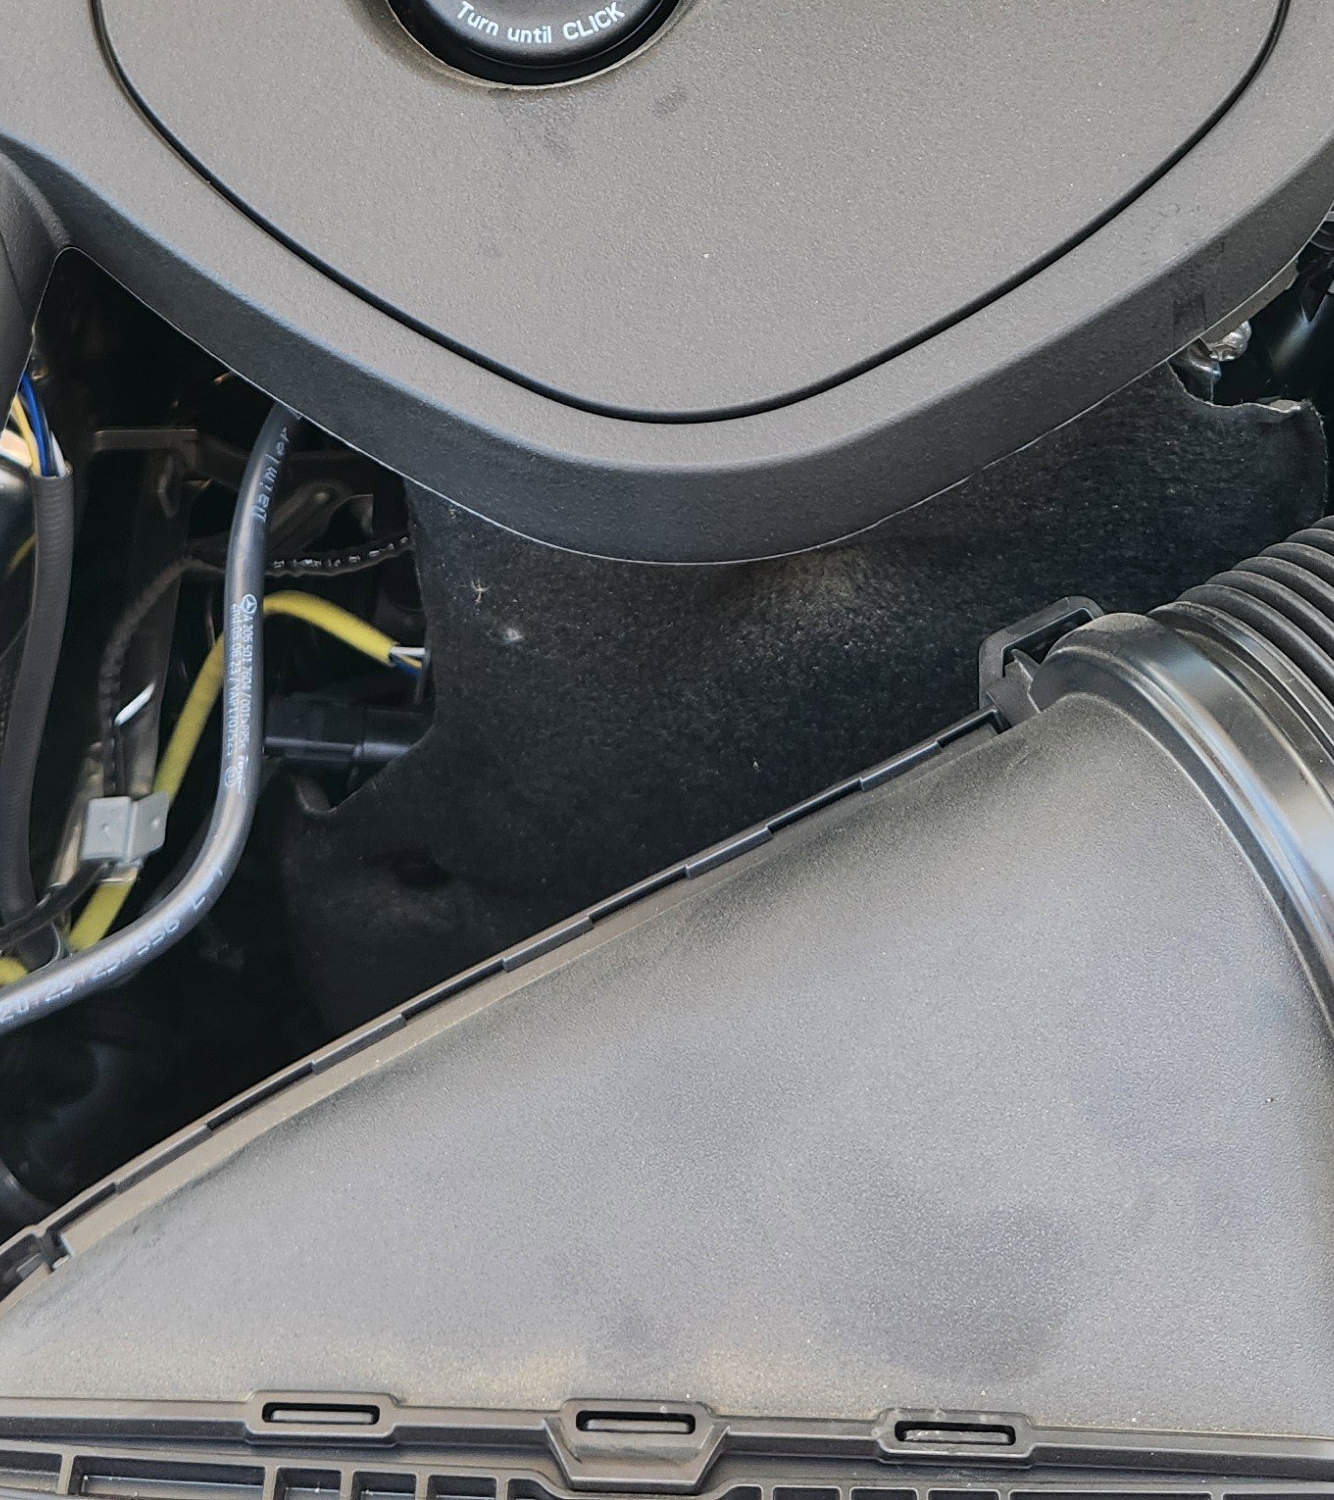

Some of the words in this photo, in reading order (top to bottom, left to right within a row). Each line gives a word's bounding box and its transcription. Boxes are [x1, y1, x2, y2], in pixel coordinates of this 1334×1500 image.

[457, 1, 499, 36] Turn
[507, 25, 552, 44] until
[563, 2, 626, 41] CLICK
